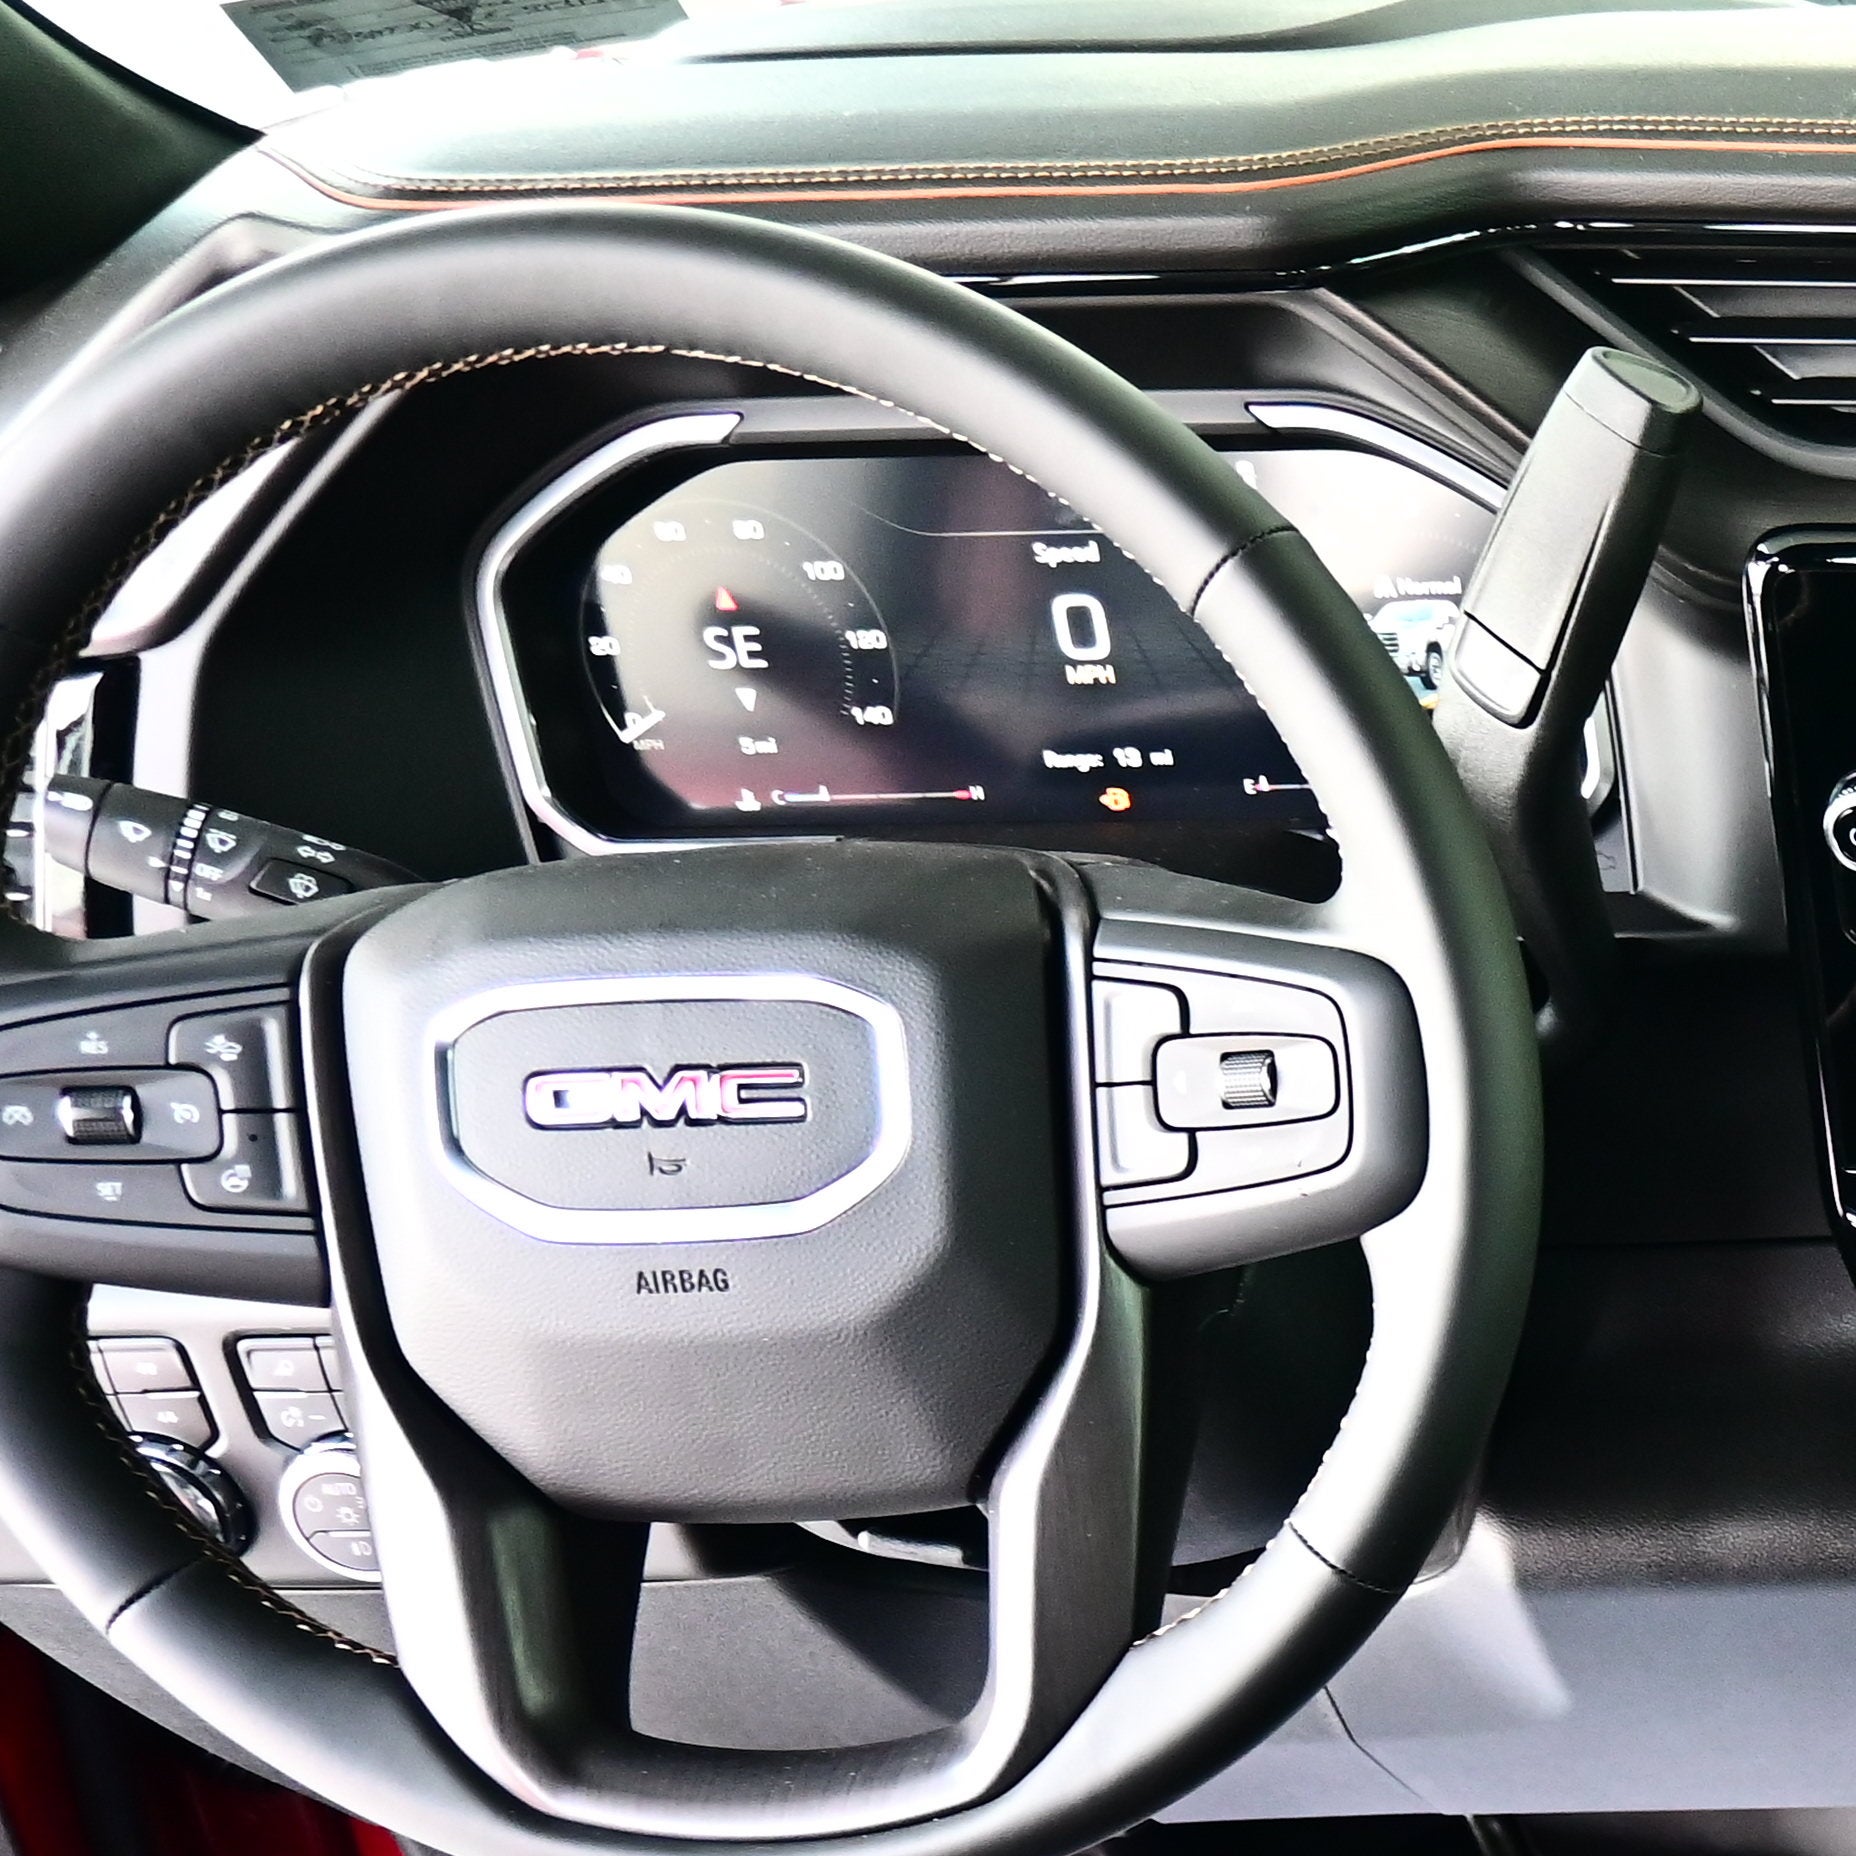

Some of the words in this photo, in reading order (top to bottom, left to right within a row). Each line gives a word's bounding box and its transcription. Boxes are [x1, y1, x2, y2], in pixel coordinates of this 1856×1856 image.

[1032, 540, 1101, 568] Speed
[802, 560, 845, 581] 100
[1051, 592, 1111, 661] 0
[703, 625, 769, 670] SE
[845, 629, 888, 650] 120
[1065, 664, 1117, 685] MPH
[851, 705, 894, 725] 140
[633, 738, 665, 750] MPH
[522, 1062, 810, 1131] GMC
[636, 1268, 730, 1295] AIRBAG
